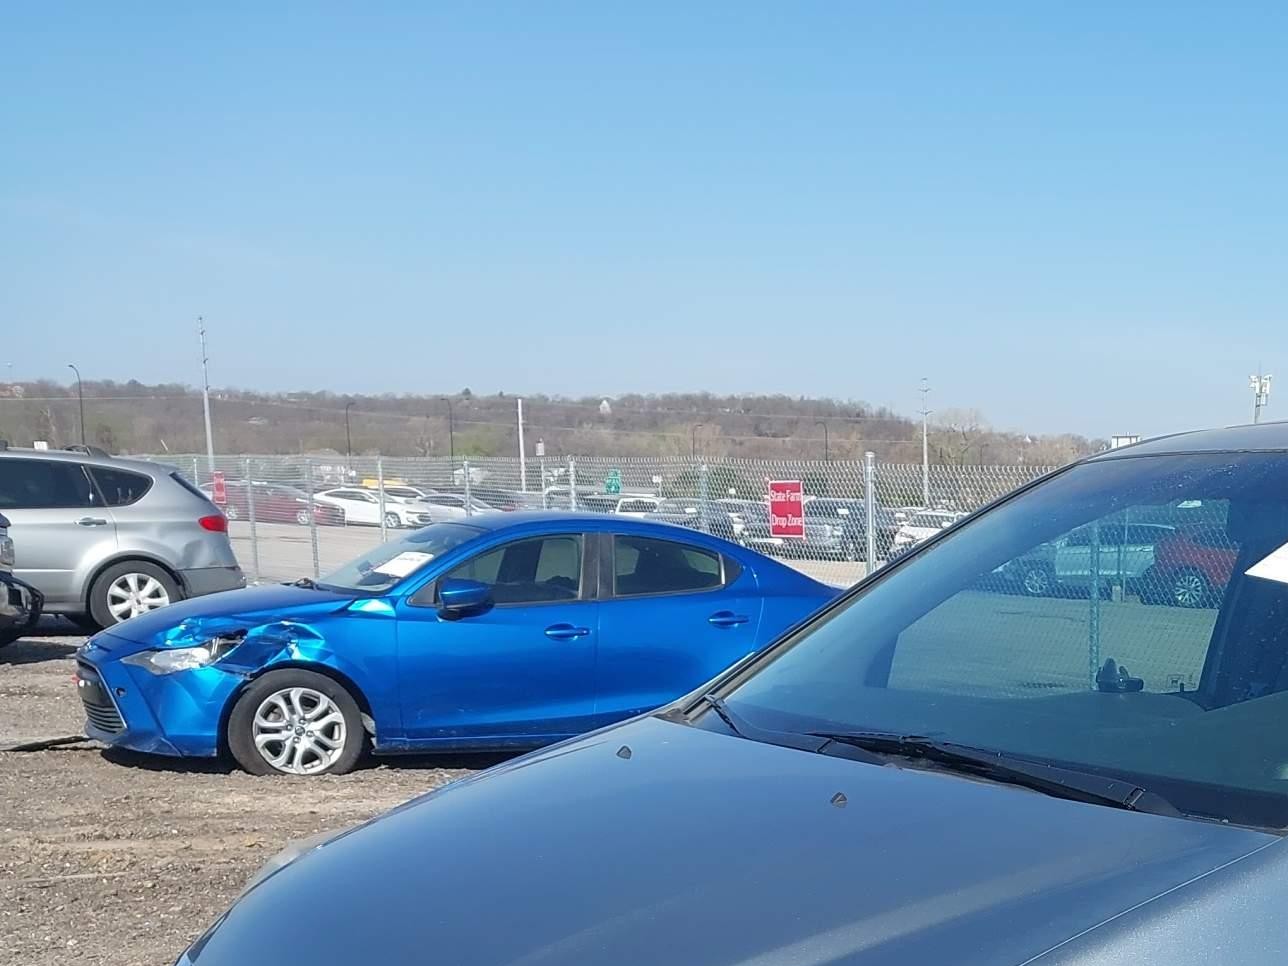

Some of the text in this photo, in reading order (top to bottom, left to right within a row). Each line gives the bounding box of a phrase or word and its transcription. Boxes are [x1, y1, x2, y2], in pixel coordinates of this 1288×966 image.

[770, 490, 802, 502] State Farm
[772, 514, 803, 528] Drop Zone
